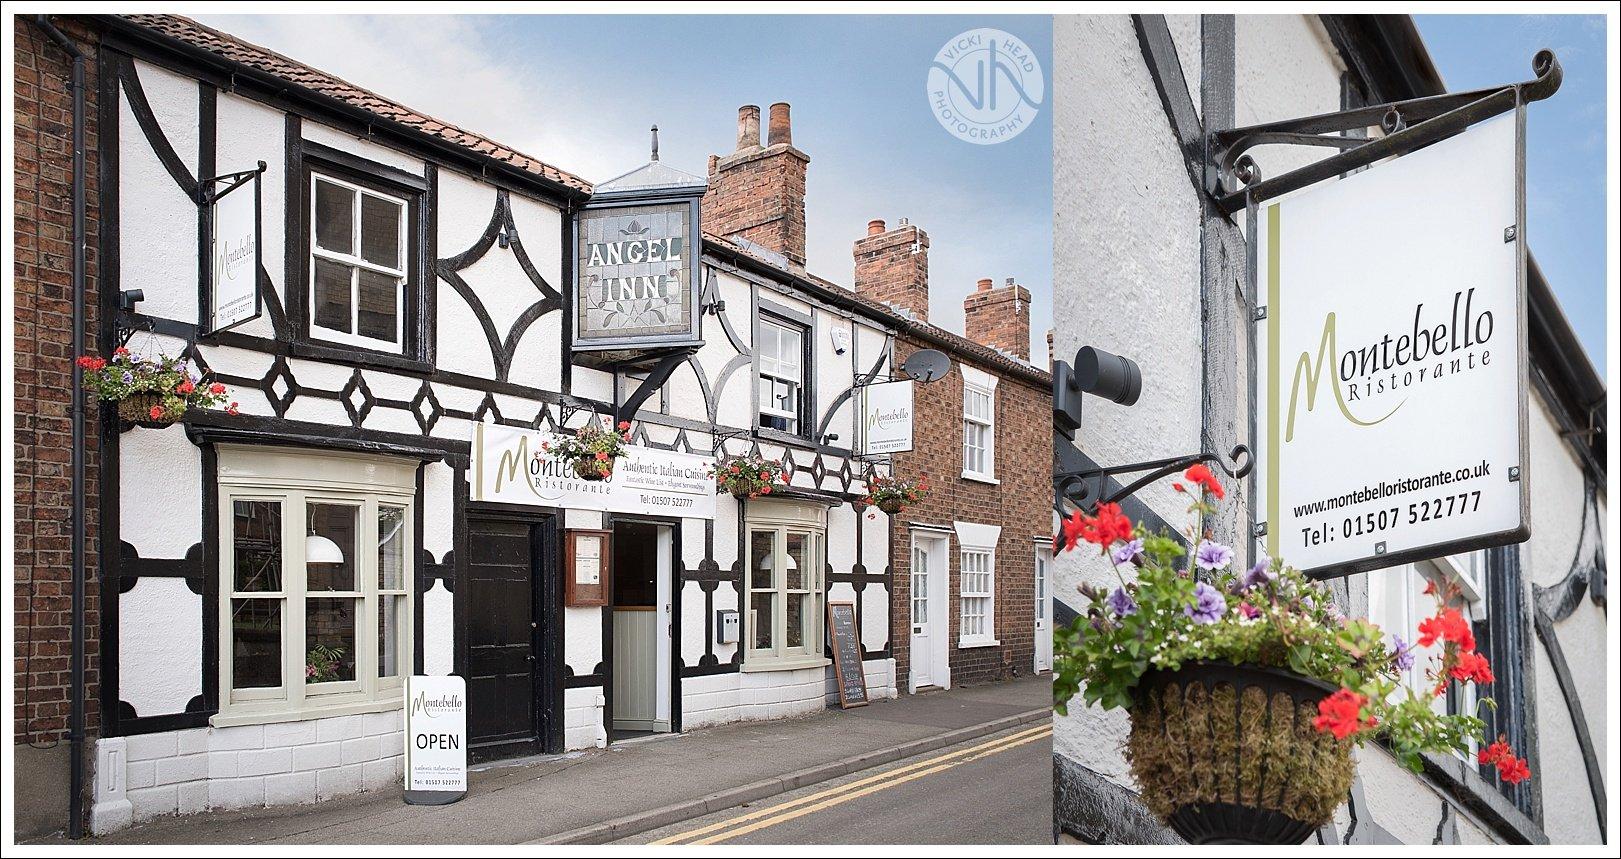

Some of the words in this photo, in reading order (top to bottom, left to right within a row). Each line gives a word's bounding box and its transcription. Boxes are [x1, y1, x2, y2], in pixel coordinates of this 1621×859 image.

[217, 234, 255, 286] Montebello
[587, 237, 682, 268] ANGEL
[605, 276, 661, 303] INN
[1285, 287, 1495, 443] Montebello
[1347, 349, 1492, 402] Ristorante
[868, 408, 909, 431] Montebello
[623, 457, 658, 475] Authentic
[660, 461, 683, 478] Italian
[684, 468, 709, 481] Cuisin
[535, 477, 611, 495] Ristorante
[1293, 460, 1491, 519] www.montebelloristorante.co.uk
[640, 494, 651, 505] Tel:
[651, 496, 671, 506] 01507
[671, 499, 693, 508] 522777
[1301, 522, 1335, 549] Tel:
[1343, 507, 1400, 539] 01507
[1408, 490, 1482, 525] 522777
[411, 690, 463, 719] Montebello
[416, 733, 459, 750] OPEN
